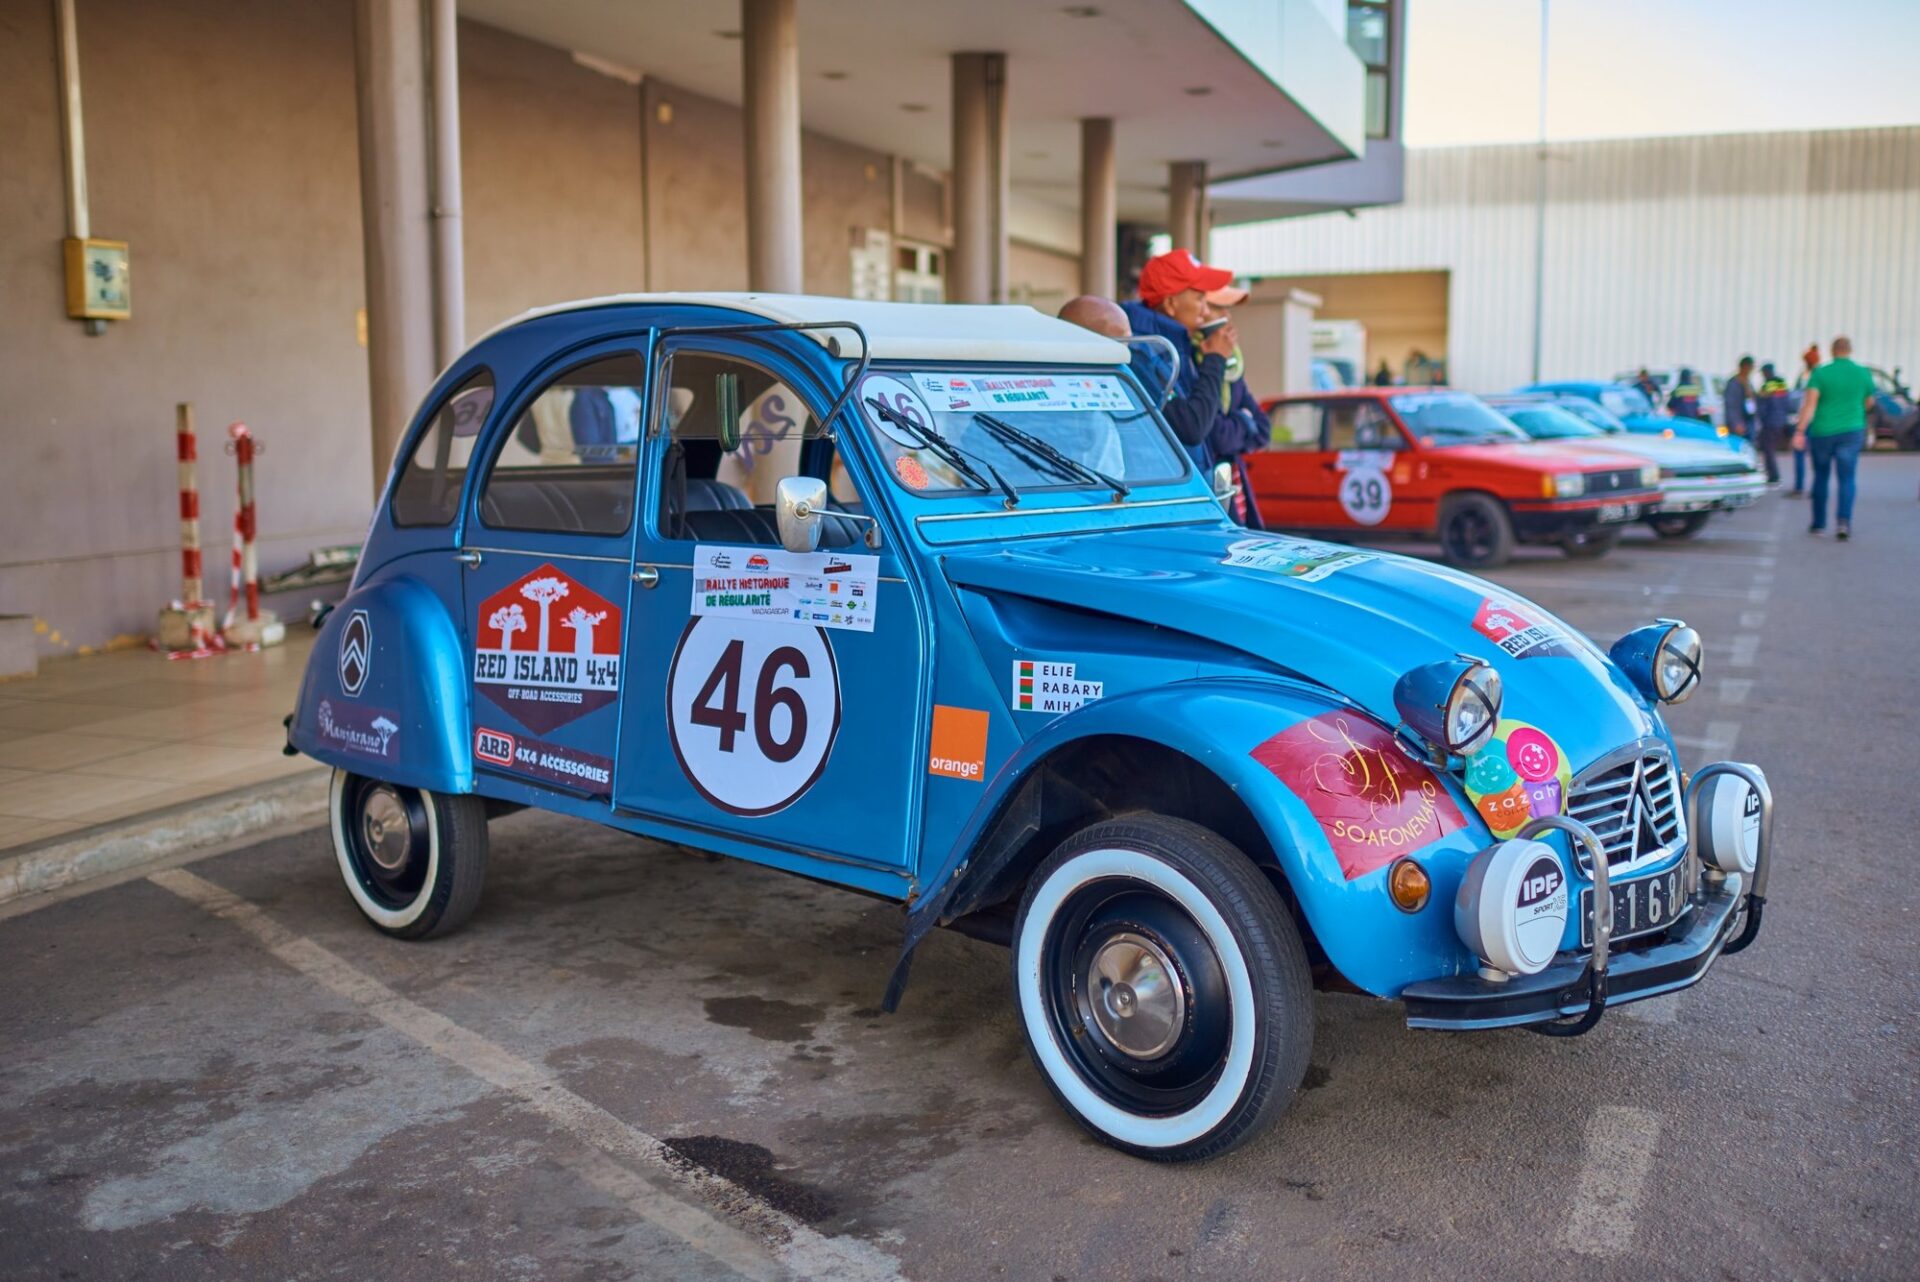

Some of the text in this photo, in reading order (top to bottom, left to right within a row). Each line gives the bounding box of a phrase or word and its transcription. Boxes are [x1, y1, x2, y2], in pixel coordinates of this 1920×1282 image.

[1349, 478, 1382, 511] 39
[706, 578, 737, 590] RALLYE
[739, 577, 790, 590] HISTORIQUE
[706, 590, 771, 607] DE RÉGULARITÉ
[476, 653, 617, 686] RED ISLAND 4x4
[1043, 665, 1073, 677] ELIE
[508, 688, 583, 704] OFF-ROAD ACCESSORIES
[1043, 682, 1101, 696] RABARY
[690, 639, 811, 763] 46
[479, 735, 610, 784] ARB 4X4 ACCESSORIES
[1488, 785, 1556, 812] zazah
[1747, 793, 1760, 812] IP
[1333, 780, 1436, 847] SOAFONENAKO
[1523, 872, 1558, 902] IPF
[1533, 902, 1553, 915] SPORT
